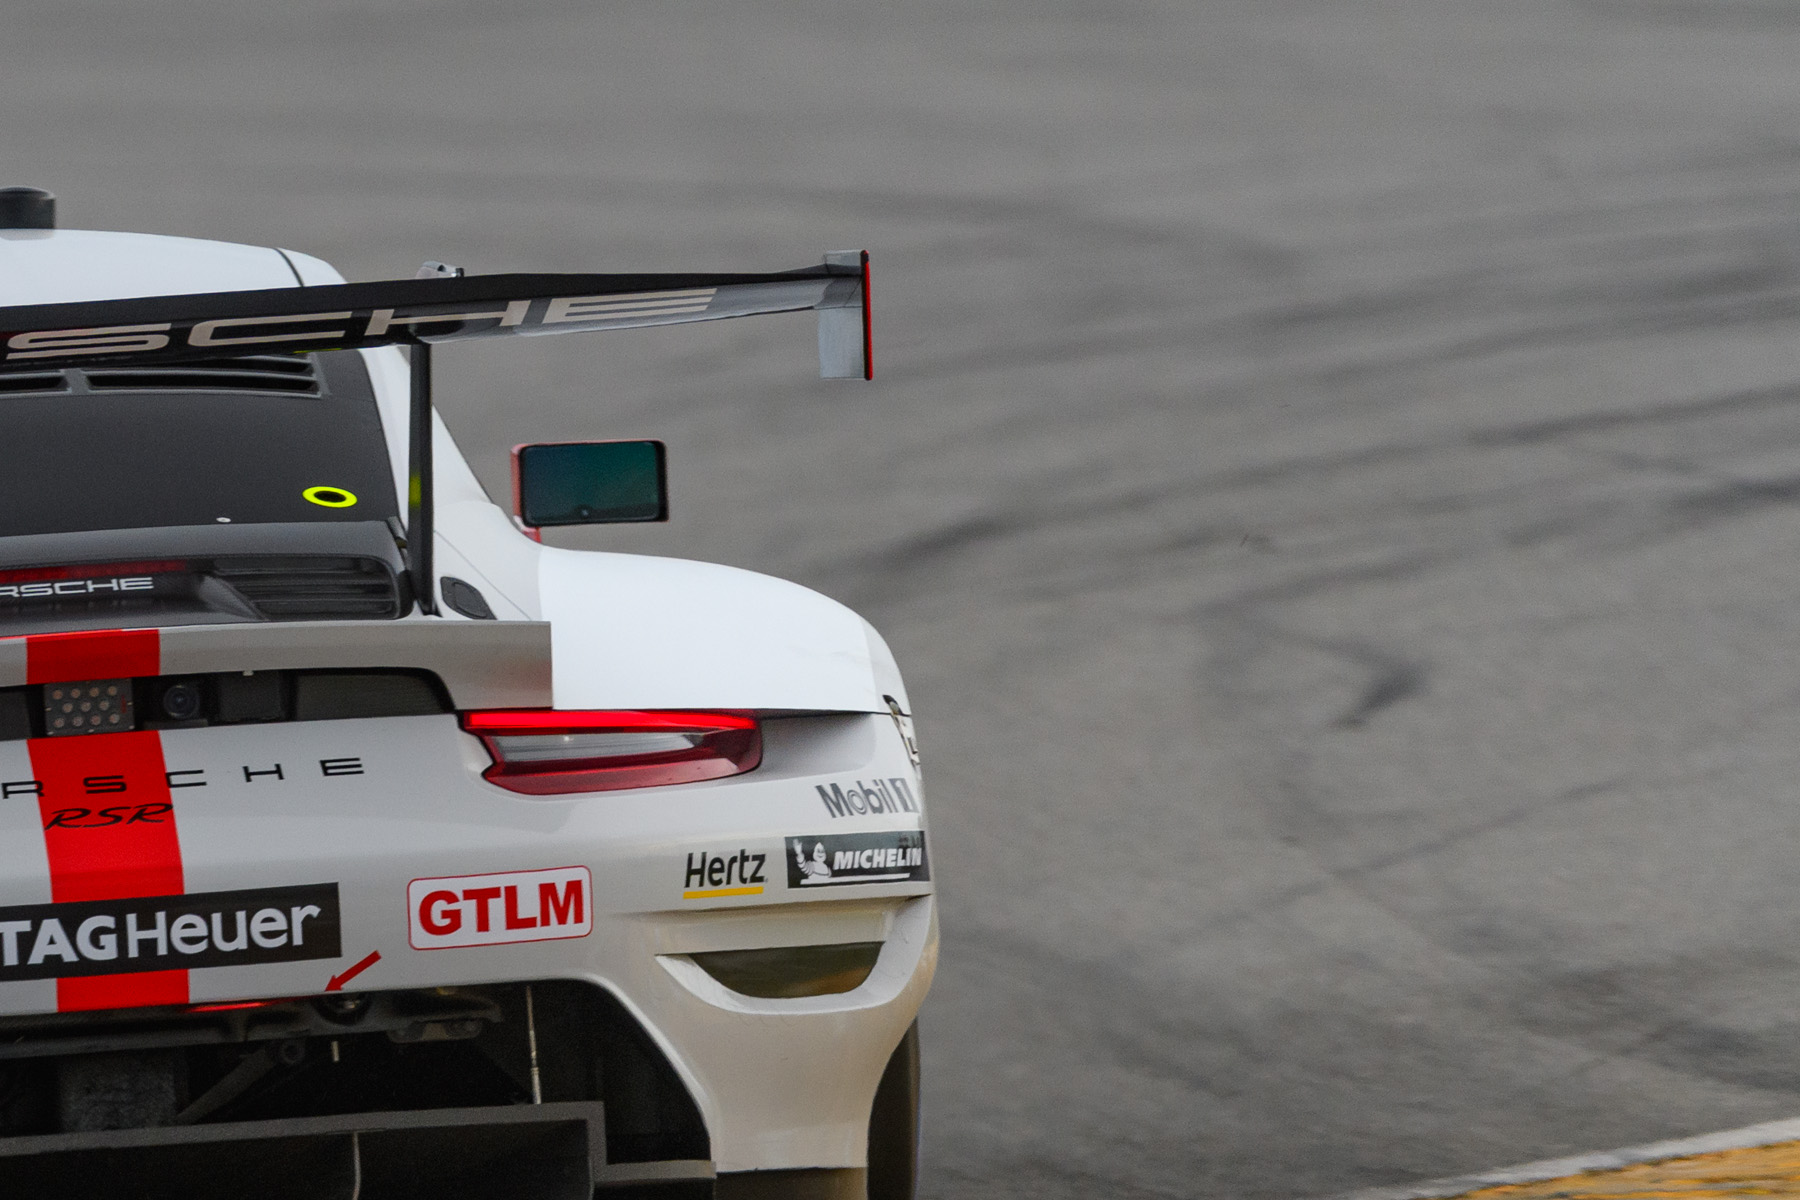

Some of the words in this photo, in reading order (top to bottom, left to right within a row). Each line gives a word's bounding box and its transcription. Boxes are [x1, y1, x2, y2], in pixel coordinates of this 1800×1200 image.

[44, 802, 174, 831] RSR
[814, 779, 899, 818] Mobil
[685, 849, 766, 889] Hertz
[832, 847, 922, 870] MICHELIN
[418, 880, 584, 936] GTLM
